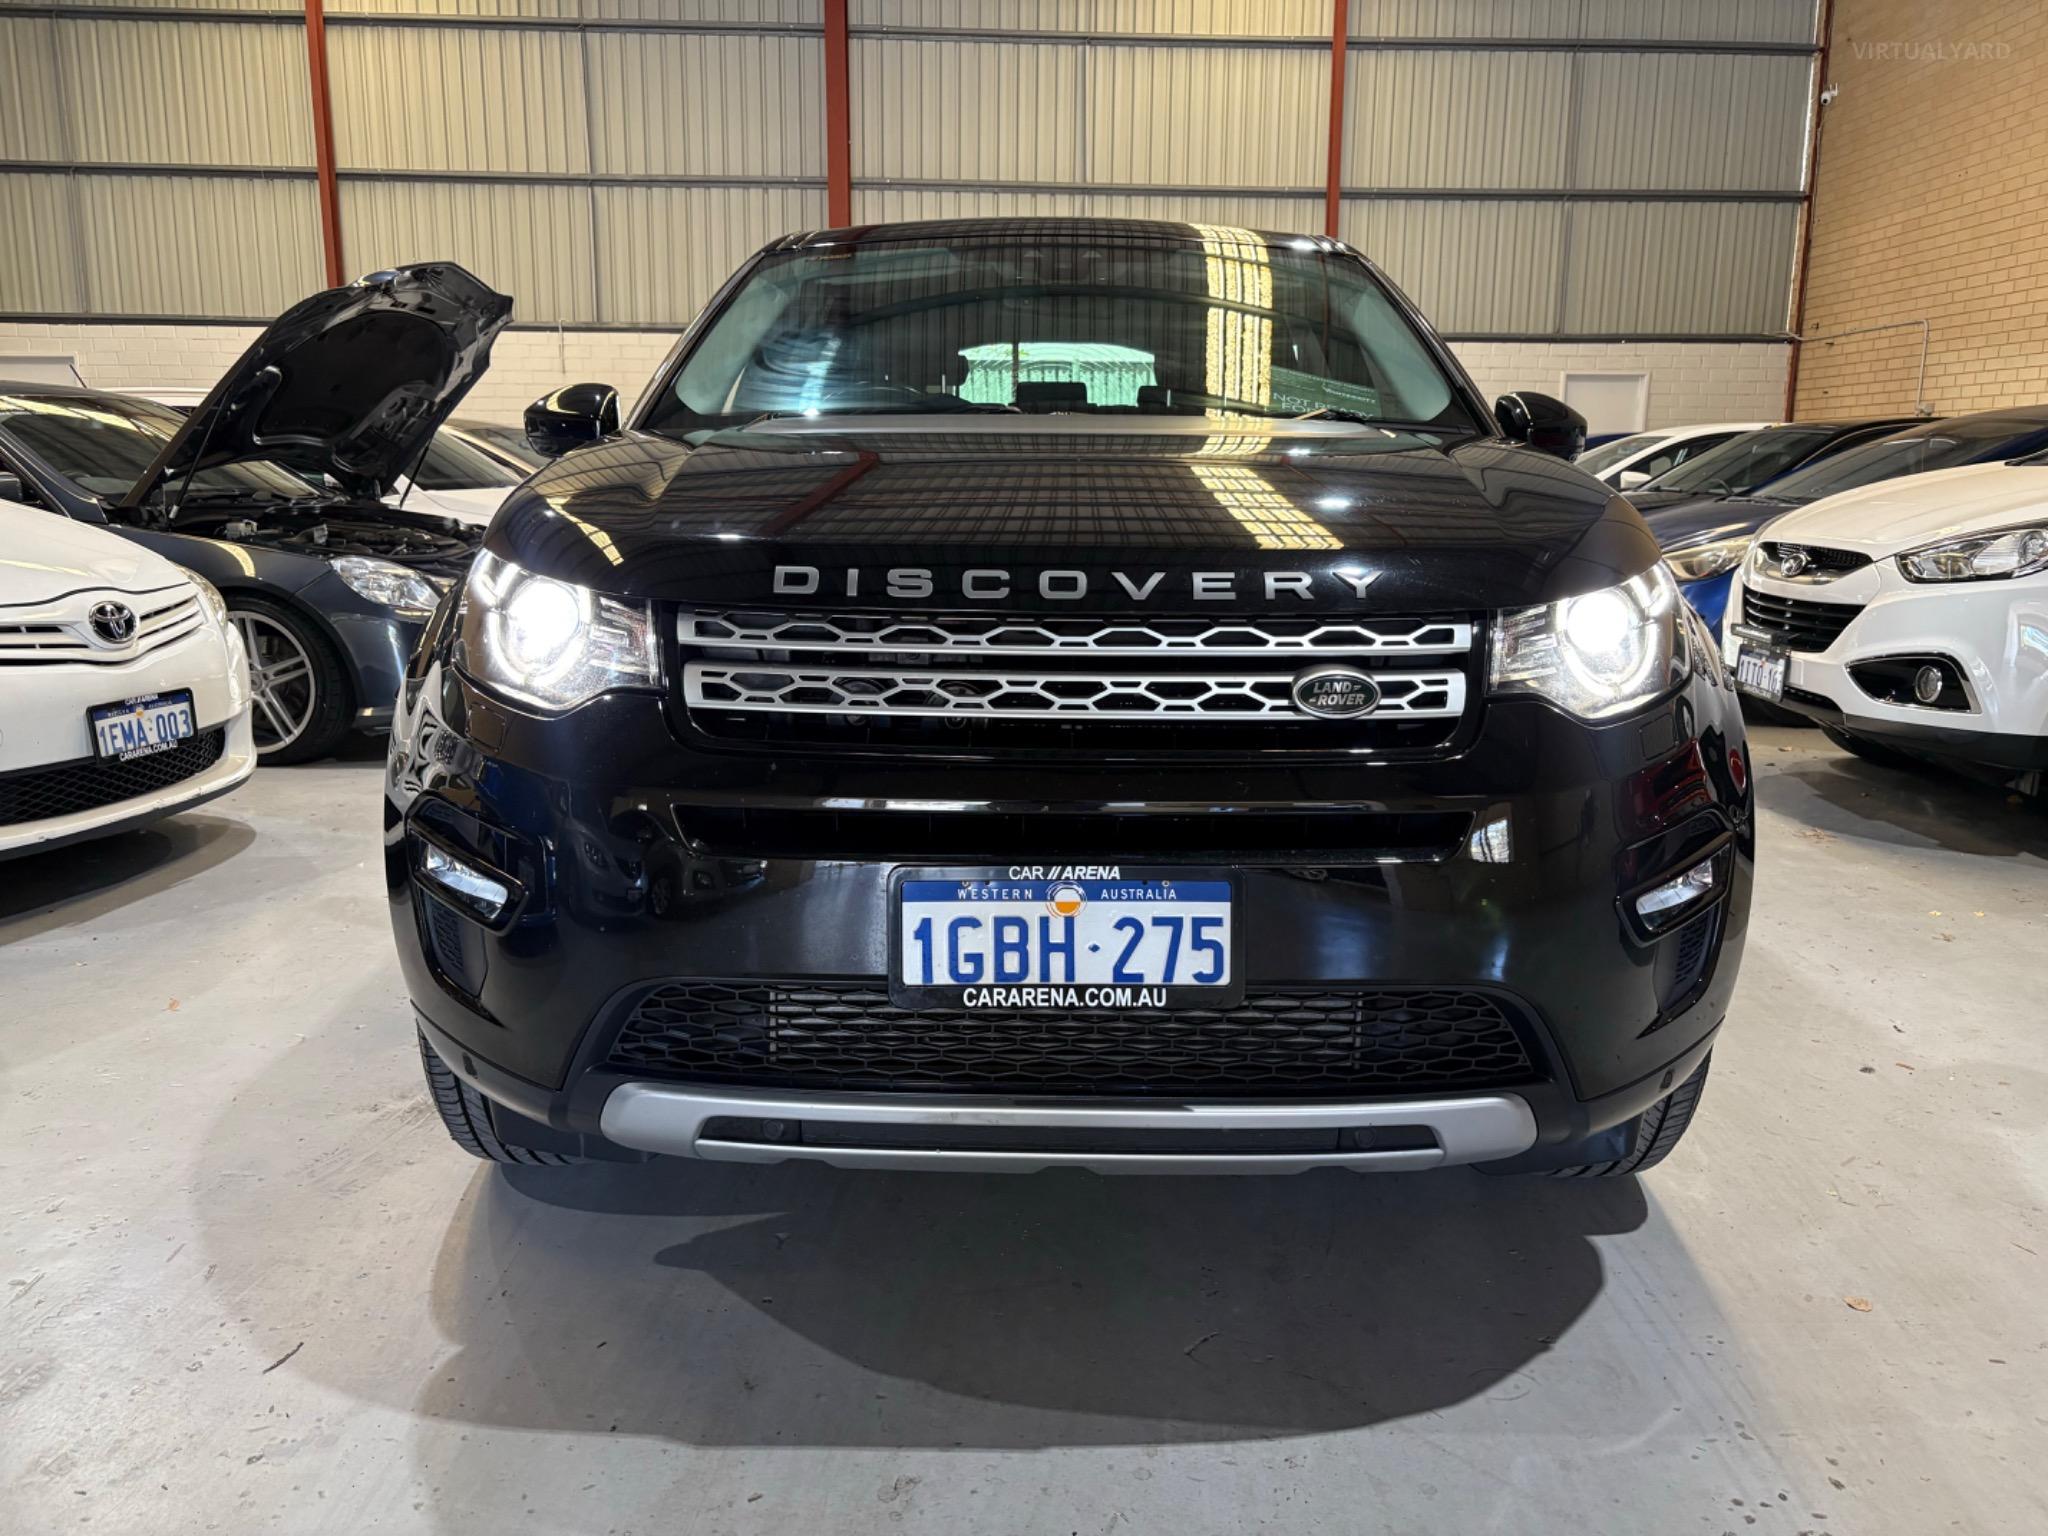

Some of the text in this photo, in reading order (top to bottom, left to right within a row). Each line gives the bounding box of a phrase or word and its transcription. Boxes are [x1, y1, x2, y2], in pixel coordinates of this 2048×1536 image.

[1273, 392, 1311, 407] NOT
[773, 565, 1384, 600] DISCOVERY
[1313, 682, 1352, 693] LAND
[1317, 694, 1365, 705] ROVER
[1009, 866, 1044, 880] CAR
[957, 888, 1177, 900] WESTERN AUSTRALIA
[963, 988, 1167, 1007] CARARENA.COM.AU
